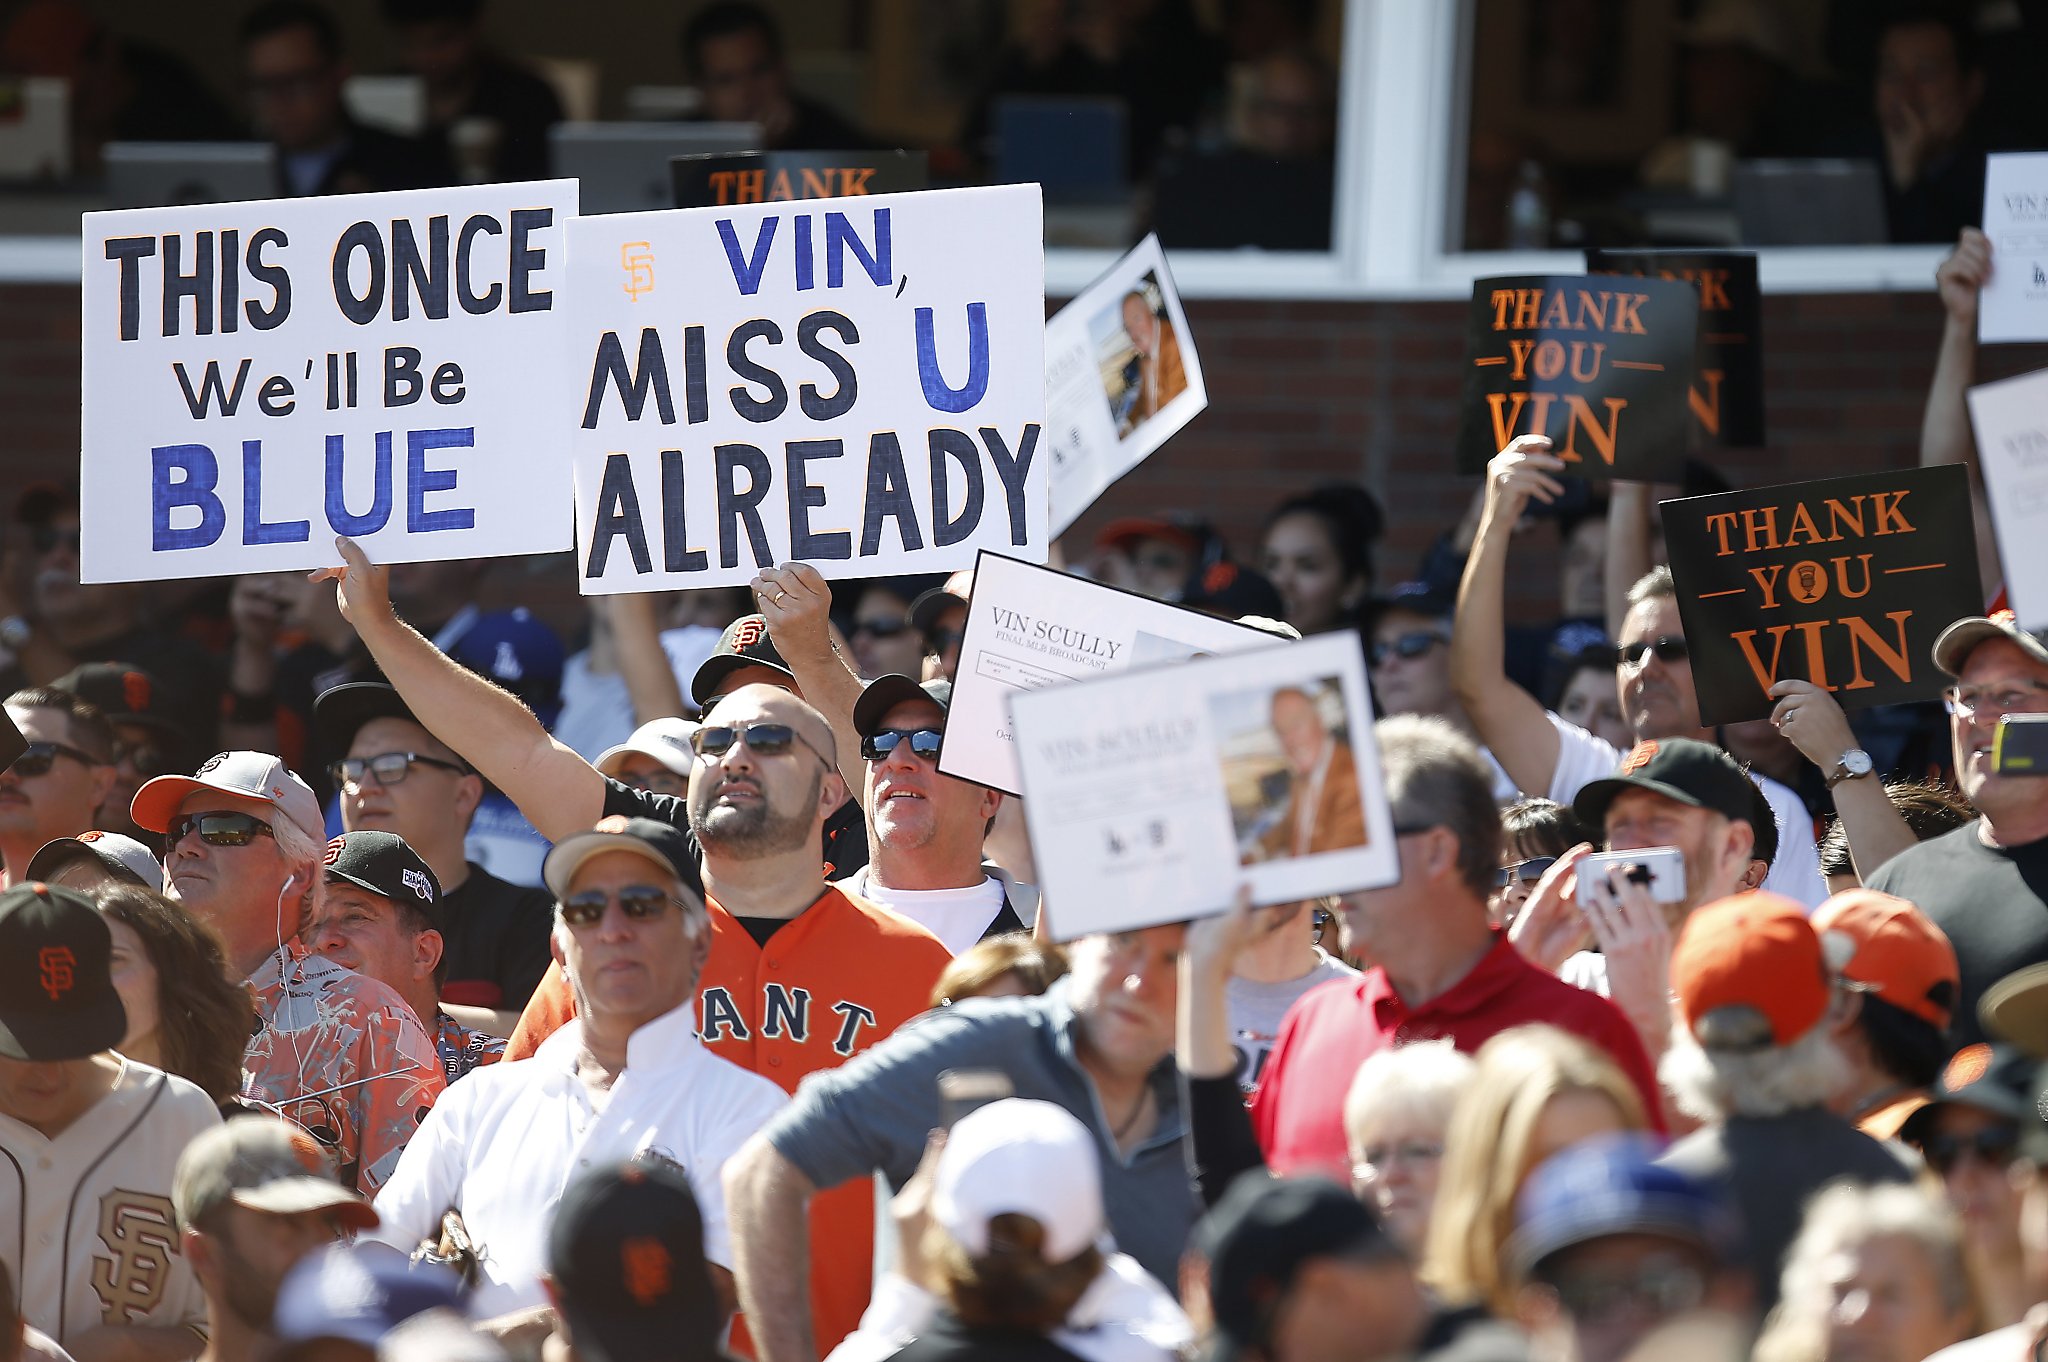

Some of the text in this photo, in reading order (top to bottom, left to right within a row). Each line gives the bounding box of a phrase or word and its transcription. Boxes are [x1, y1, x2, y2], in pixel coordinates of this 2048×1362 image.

[708, 167, 877, 206] THANK
[104, 207, 554, 342] THIS ONCE
[715, 207, 907, 299] VIN,
[1491, 288, 1649, 335] THANK
[172, 346, 466, 420] We'll Be
[580, 302, 990, 429] MISS U
[1509, 339, 1607, 383] YOU
[1486, 392, 1628, 465] VIN
[151, 427, 475, 552] BLUE
[585, 423, 1041, 579] ALREADY
[1706, 490, 1917, 556] THANK
[1748, 553, 1874, 609] YOU
[992, 606, 1122, 660] VIN SCULLY
[995, 630, 1107, 671] FINAL MLB BROADCAST
[1730, 610, 1914, 701] VIN
